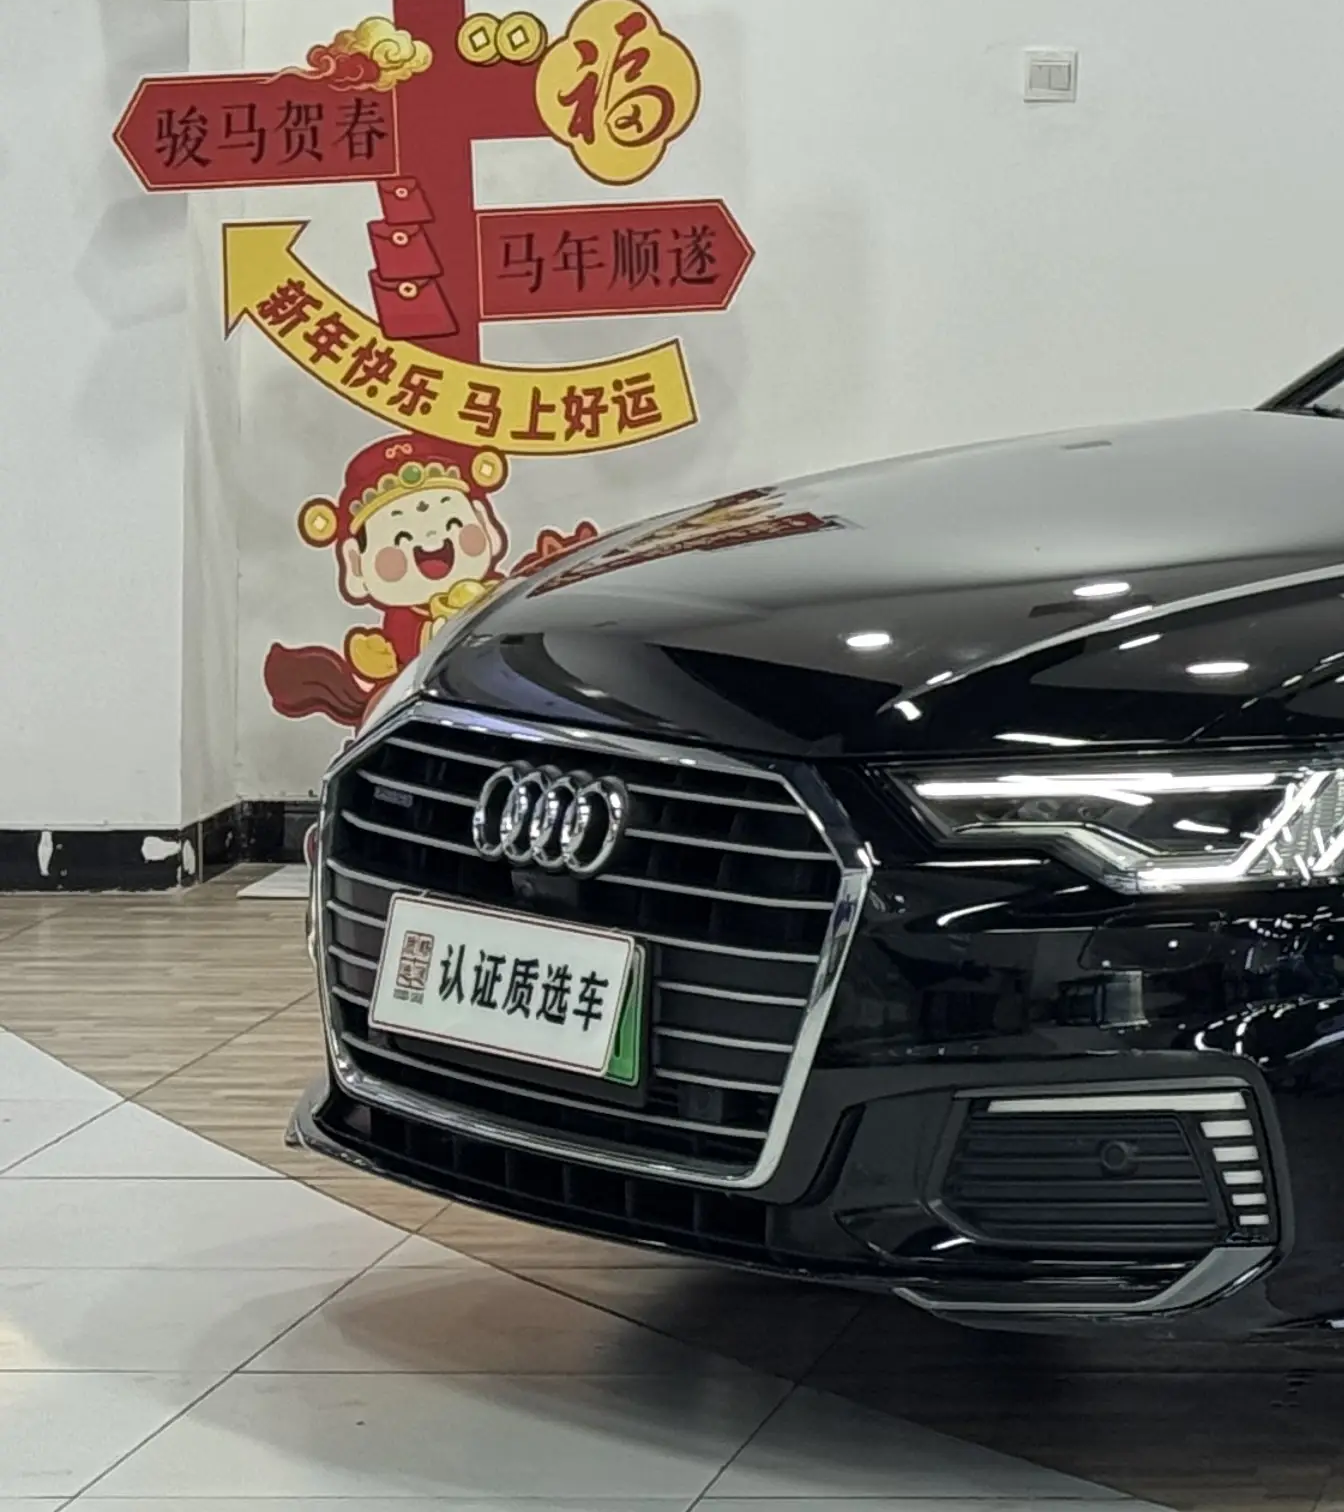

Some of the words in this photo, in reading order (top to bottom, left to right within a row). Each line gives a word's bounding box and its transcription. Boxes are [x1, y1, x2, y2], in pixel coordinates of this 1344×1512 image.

[557, 10, 676, 146] 福
[154, 97, 387, 170] 骏马贺春
[497, 226, 721, 295] 马年顺遂
[257, 278, 446, 417] 新年快乐
[458, 374, 662, 442] 马上好运
[437, 944, 610, 1032] 认证质选车
